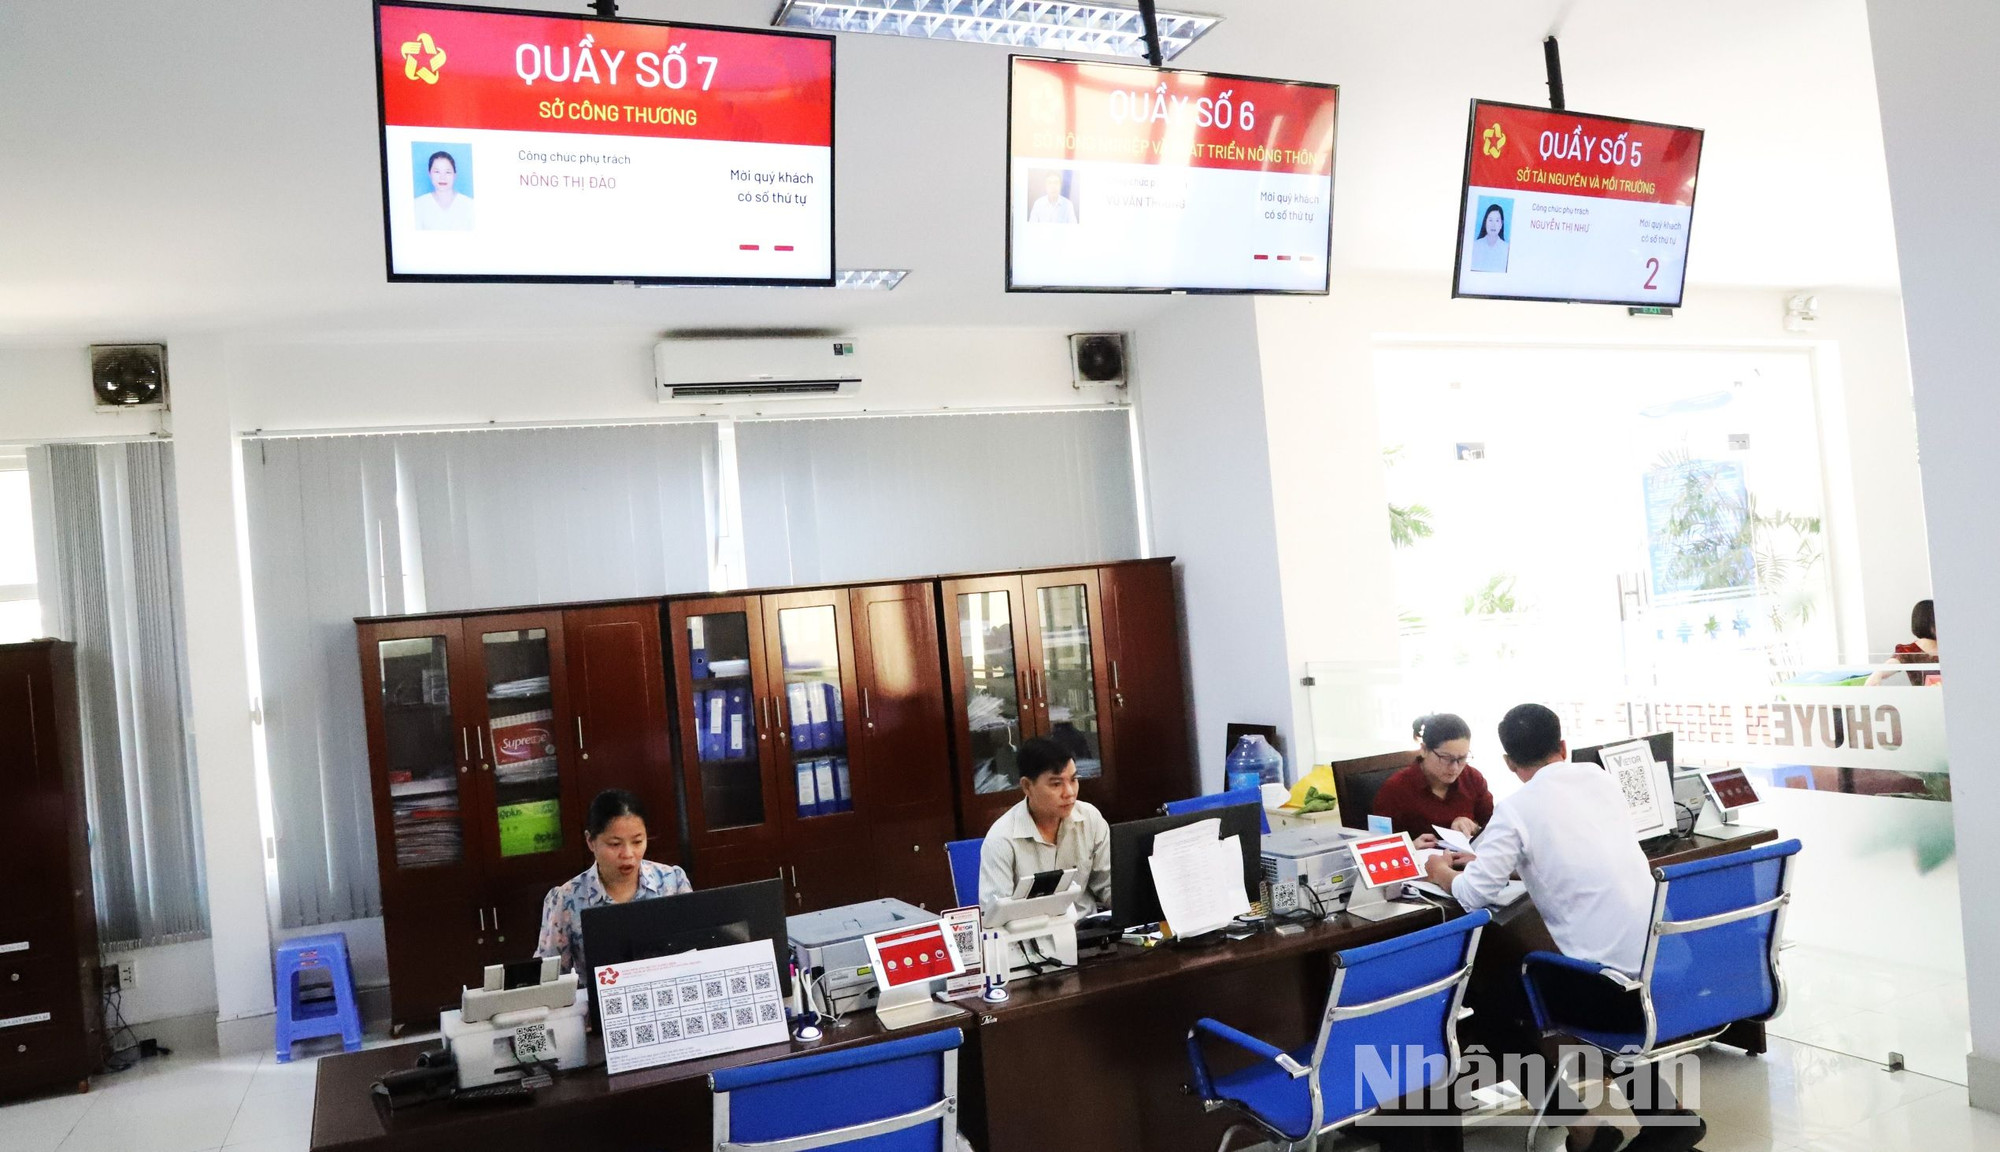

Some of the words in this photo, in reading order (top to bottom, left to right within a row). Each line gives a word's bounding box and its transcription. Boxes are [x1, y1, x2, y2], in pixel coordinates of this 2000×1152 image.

[515, 33, 625, 86] QUẦY
[635, 42, 687, 90] SỐ
[697, 56, 718, 91] 7
[539, 97, 565, 119] SỞ
[568, 100, 619, 122] CÔNG
[623, 105, 697, 126] THƯƠNG
[1109, 81, 1189, 127] QUẦY
[1196, 89, 1233, 129] SỐ
[1239, 101, 1255, 131] 6
[518, 150, 547, 163] Công
[580, 153, 600, 165] phụ
[602, 153, 631, 164] trách
[1207, 141, 1245, 161] TRIỂN
[1247, 145, 1282, 163] NÔNG
[1285, 147, 1317, 166] THÔN
[1539, 124, 1596, 162] QUẦY
[1599, 132, 1628, 166] SỐ
[1630, 142, 1643, 167] 5
[519, 172, 559, 188] NÔNG
[563, 176, 585, 191] THỊ
[730, 169, 751, 181] Mời
[754, 171, 775, 185] quý
[778, 171, 814, 184] khách
[1516, 166, 1531, 182] SỞ
[1532, 169, 1547, 184] TÀI
[1548, 172, 1587, 188] NGUYÊN
[1589, 175, 1600, 189] VÀ
[1601, 176, 1617, 191] MÔI
[1620, 179, 1656, 195] TRƯỜNG
[737, 191, 752, 202] có
[755, 190, 770, 203] số
[772, 192, 792, 204] thứ
[794, 194, 807, 207] tự
[1643, 257, 1659, 290] 2
